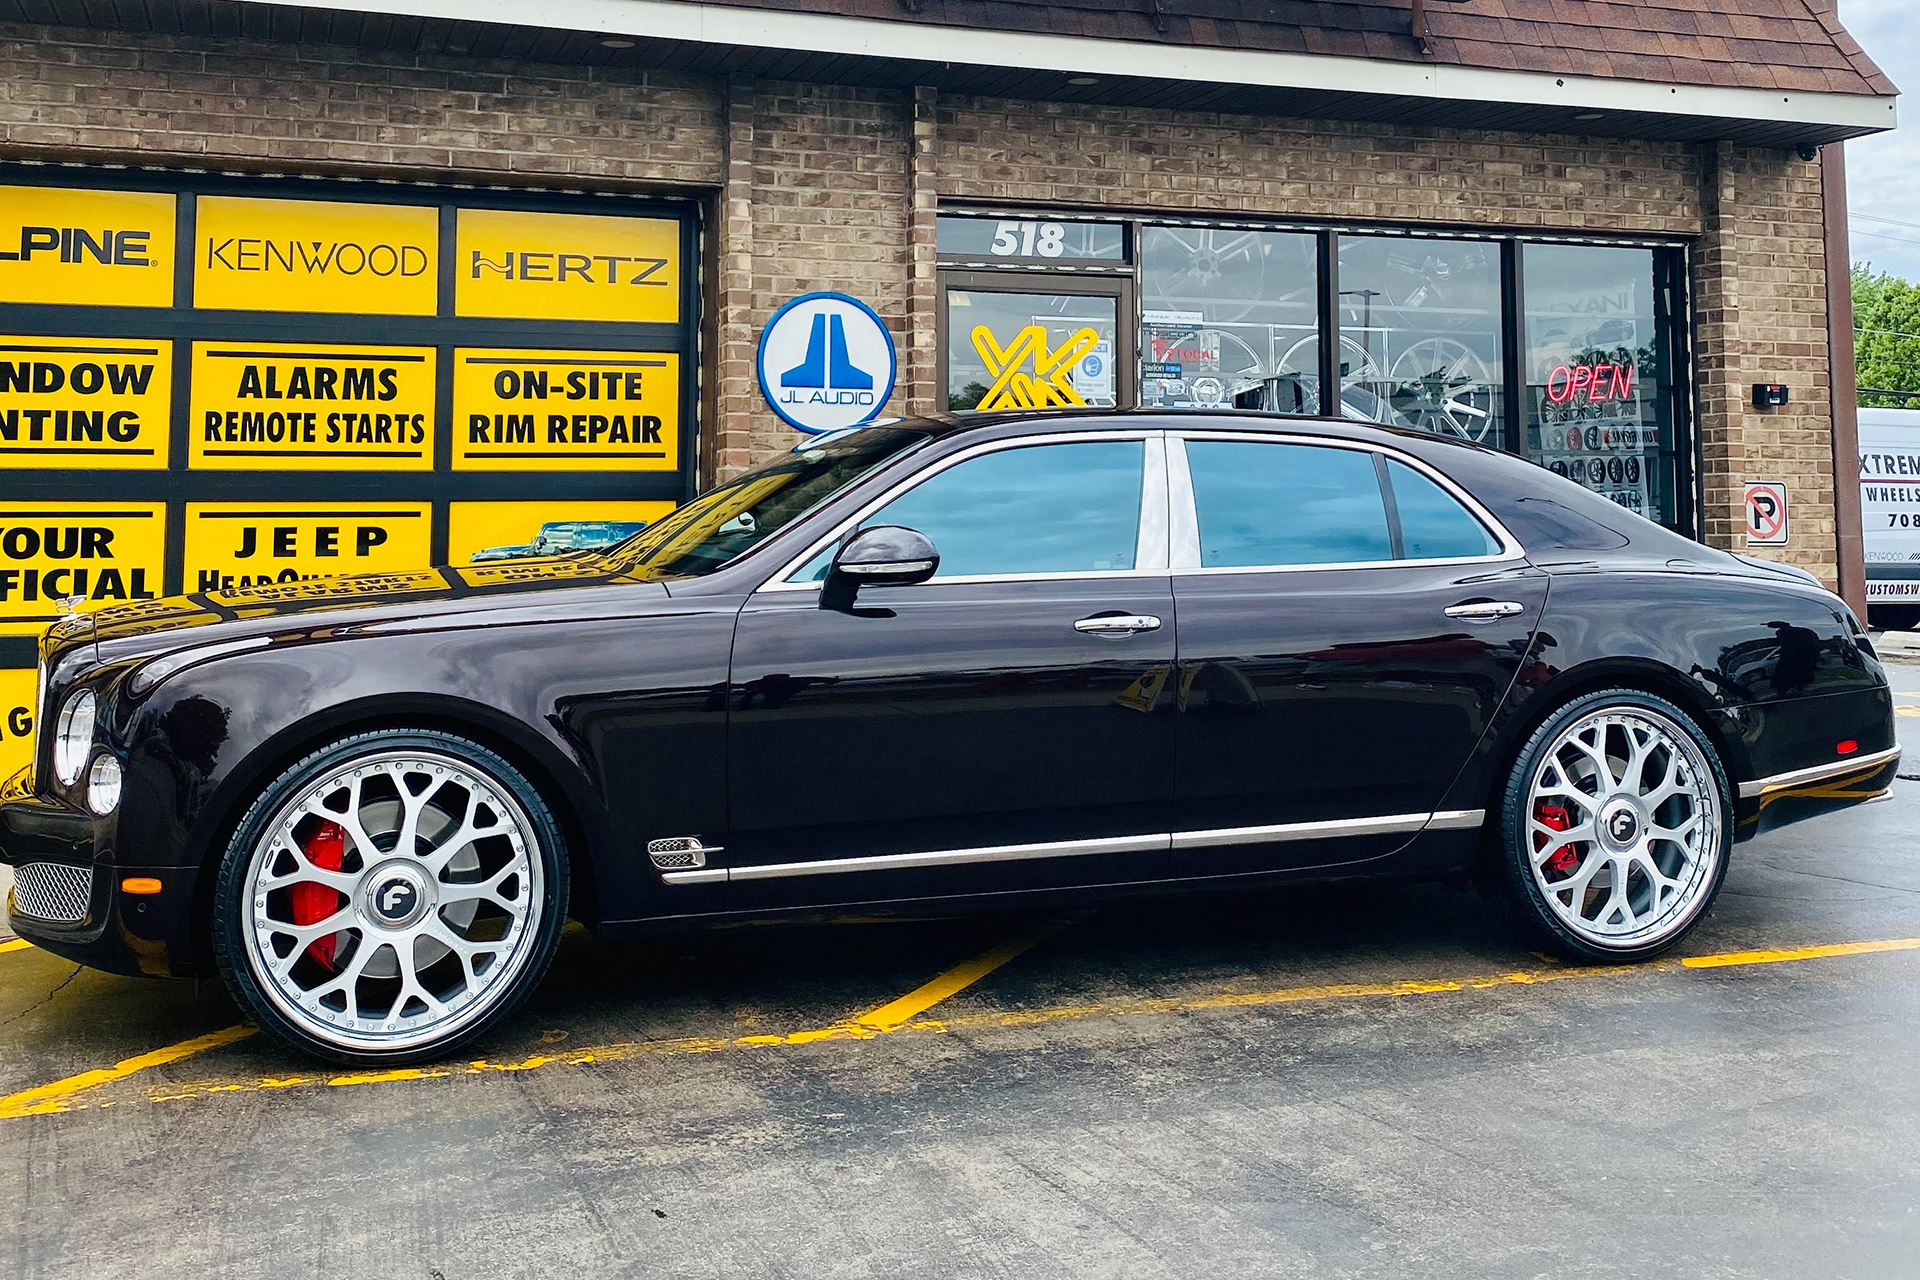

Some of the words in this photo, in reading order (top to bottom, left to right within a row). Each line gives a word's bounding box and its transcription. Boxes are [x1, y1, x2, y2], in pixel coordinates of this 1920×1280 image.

[990, 221, 1066, 257] 518
[208, 237, 428, 277] KENWOOD
[472, 250, 668, 286] HERTZ
[1177, 349, 1217, 359] FOCAL
[237, 365, 397, 401] ALARMS
[494, 371, 642, 401] ON-SITE
[780, 390, 804, 403] JL
[809, 391, 873, 405] AUDIO
[1547, 364, 1633, 403] OPEN
[204, 411, 316, 443] REMOTE
[325, 413, 425, 444] STARTS
[469, 414, 535, 444] RIM
[547, 415, 662, 444] REPAIR
[1888, 514, 1920, 528] 708
[0, 527, 114, 559] OUR
[234, 527, 388, 558] JEEP
[1864, 552, 1904, 561] KENWOOD
